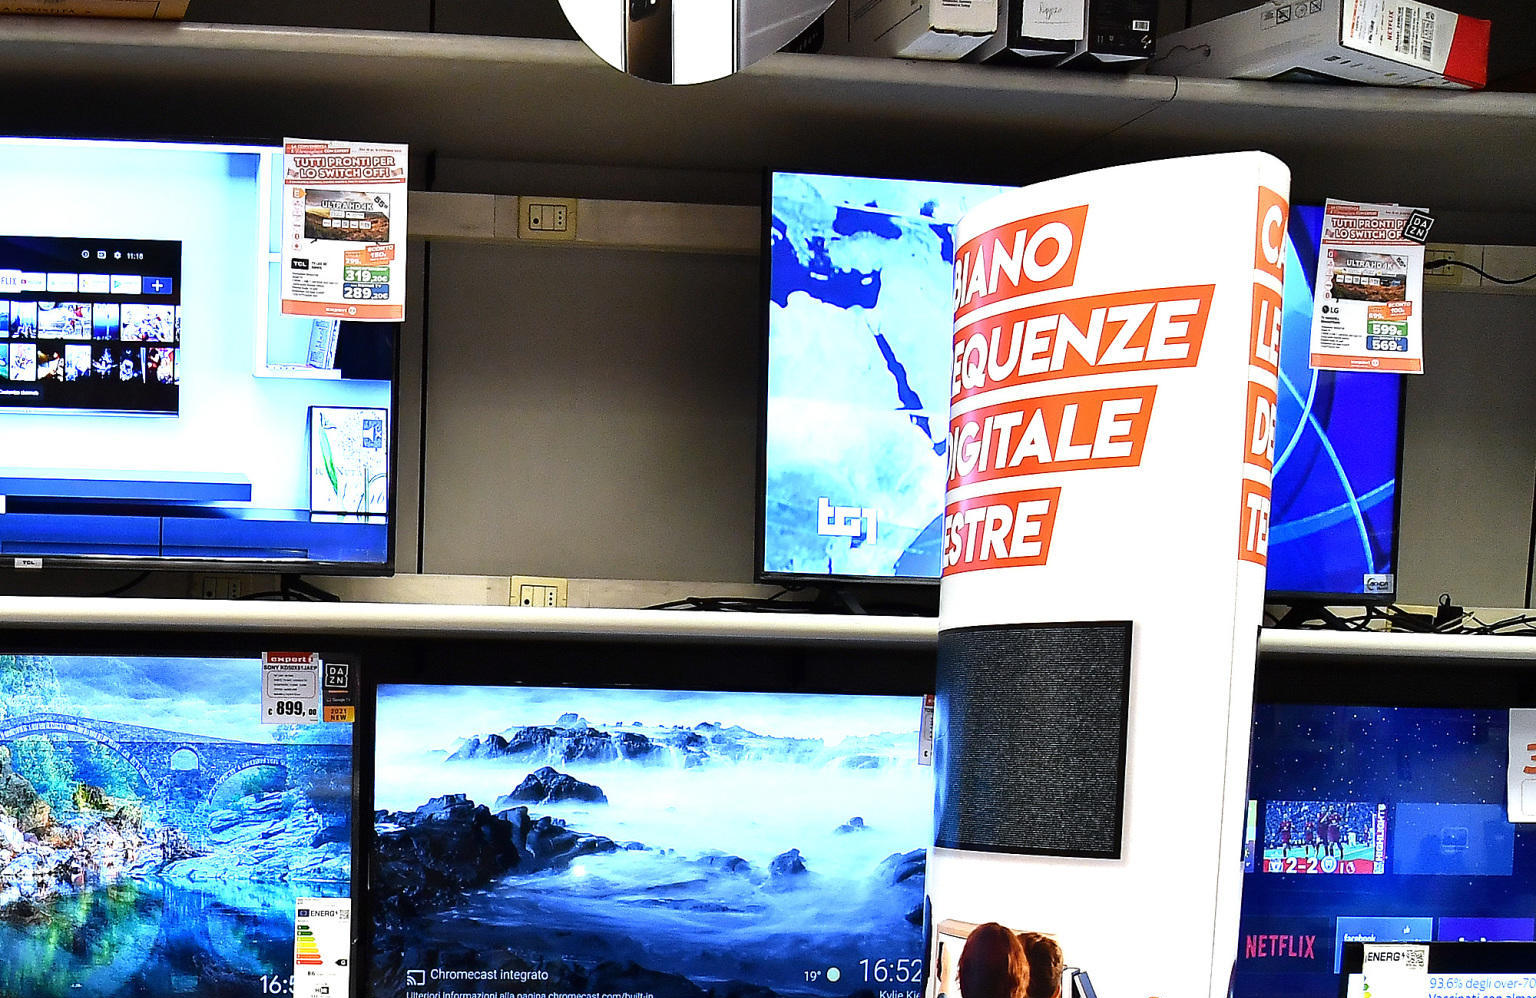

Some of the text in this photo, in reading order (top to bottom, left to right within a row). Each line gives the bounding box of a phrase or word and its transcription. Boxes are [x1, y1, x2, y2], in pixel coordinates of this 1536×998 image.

[1386, 10, 1395, 41] NETFLIX
[294, 156, 395, 167] TUTTI PRONTI PER
[300, 167, 390, 178] LO SWITCH OFF!
[321, 200, 350, 209] ULTRA
[350, 201, 362, 210] HD
[1331, 218, 1395, 229] TUTTI PRONTI
[1334, 230, 1348, 239] LO
[1350, 230, 1386, 239] SWITCH
[1346, 259, 1365, 268] ULTRA
[1330, 306, 1340, 314] LG
[952, 298, 1201, 398] EQUENZE
[1375, 803, 1387, 861] HIGHLIGHTS
[1285, 857, 1318, 874] 2-2
[1245, 934, 1316, 959] NETFLIX
[1367, 951, 1401, 962] ENERG
[430, 968, 549, 983] Chromecast integrato
[859, 958, 922, 983] 16:52
[1465, 977, 1491, 992] degli
